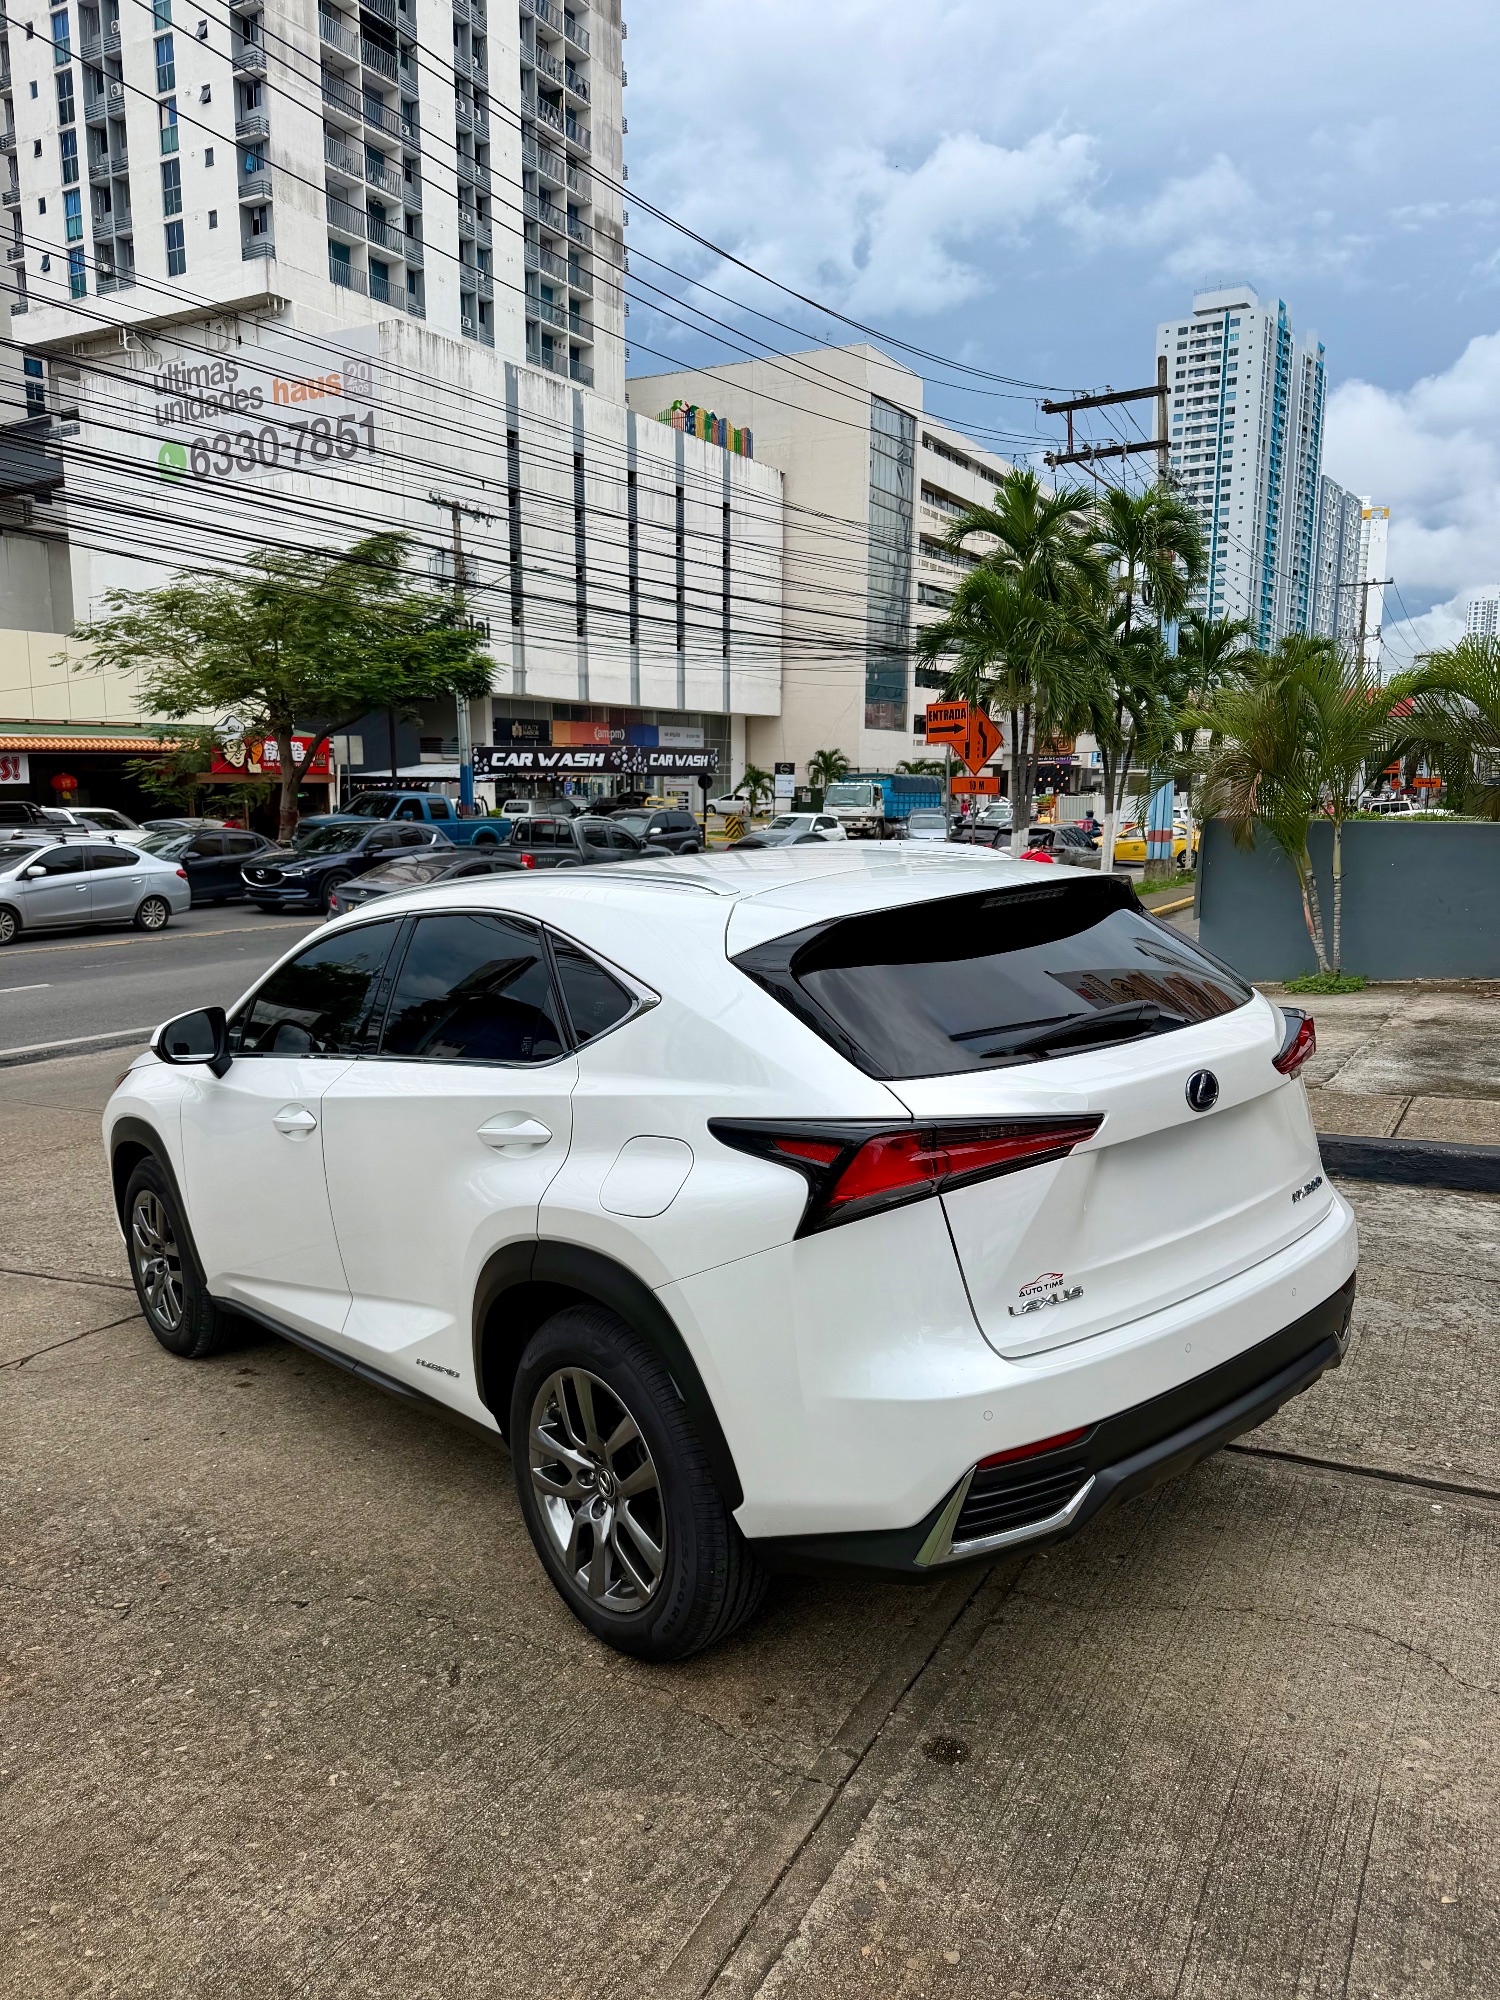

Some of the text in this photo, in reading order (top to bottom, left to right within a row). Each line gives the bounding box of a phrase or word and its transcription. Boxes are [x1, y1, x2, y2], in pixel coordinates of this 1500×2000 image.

[153, 359, 239, 396] últimas
[346, 362, 369, 386] 20
[272, 373, 341, 405] haus
[155, 383, 264, 426] unidades
[190, 410, 375, 479] 6330-7851
[928, 708, 967, 722] ENTRADA
[490, 752, 605, 767] CAR WASH
[649, 753, 709, 767] CAR WASH
[979, 781, 985, 791] M
[1007, 1284, 1084, 1317] LEXUS
[1019, 1279, 1064, 1298] AUTO TIME
